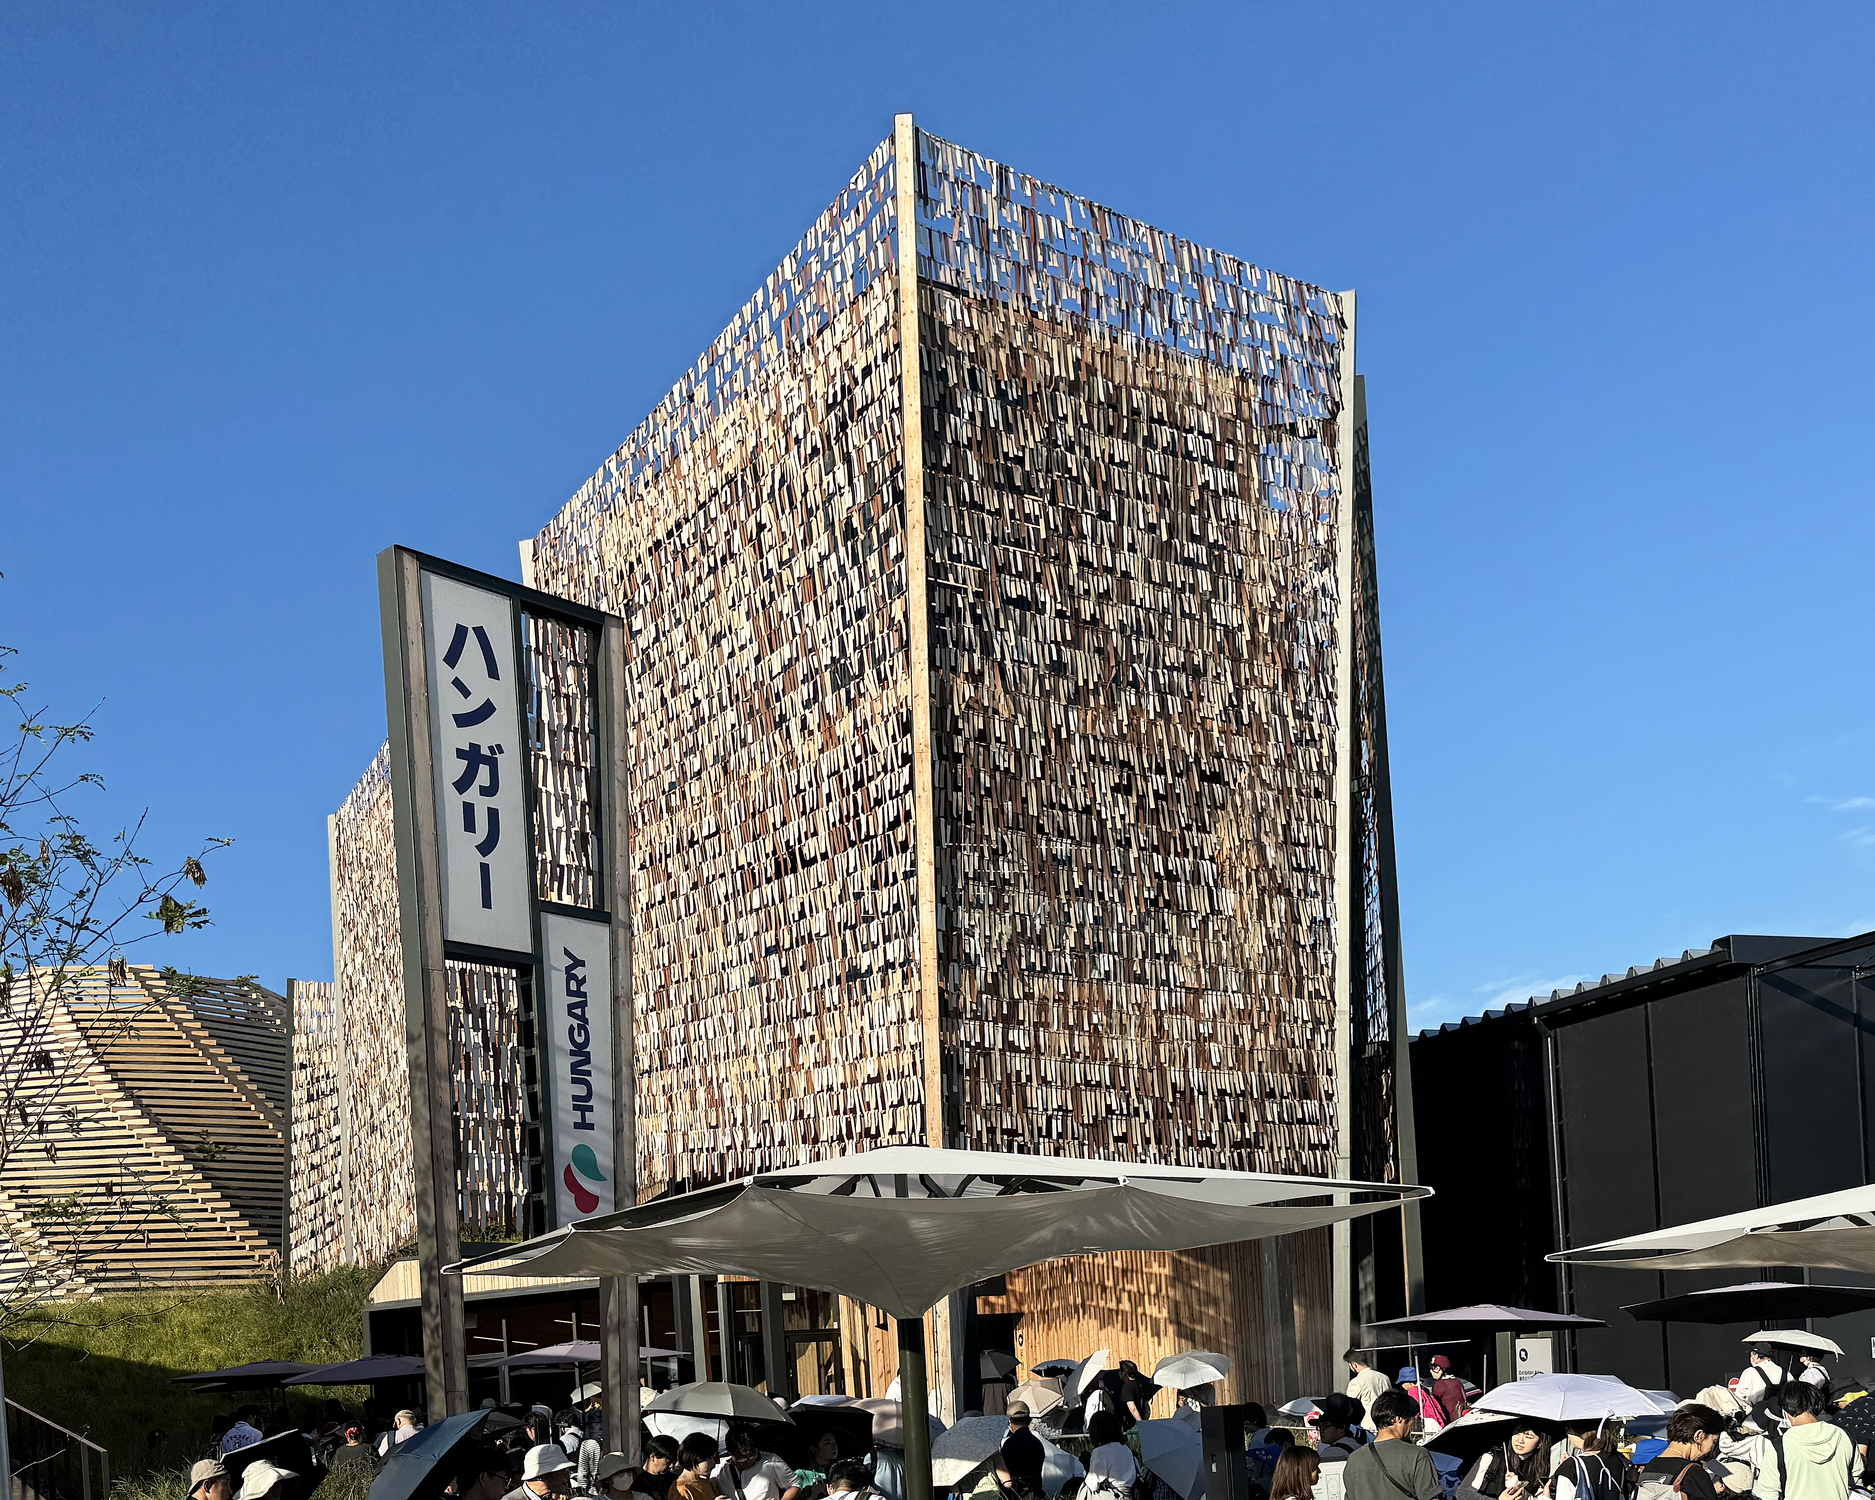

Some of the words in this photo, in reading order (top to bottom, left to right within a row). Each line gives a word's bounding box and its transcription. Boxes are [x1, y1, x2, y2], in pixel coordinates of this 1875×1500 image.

[442, 622, 505, 910] ハンガリー
[563, 946, 595, 1131] HUNGARY
